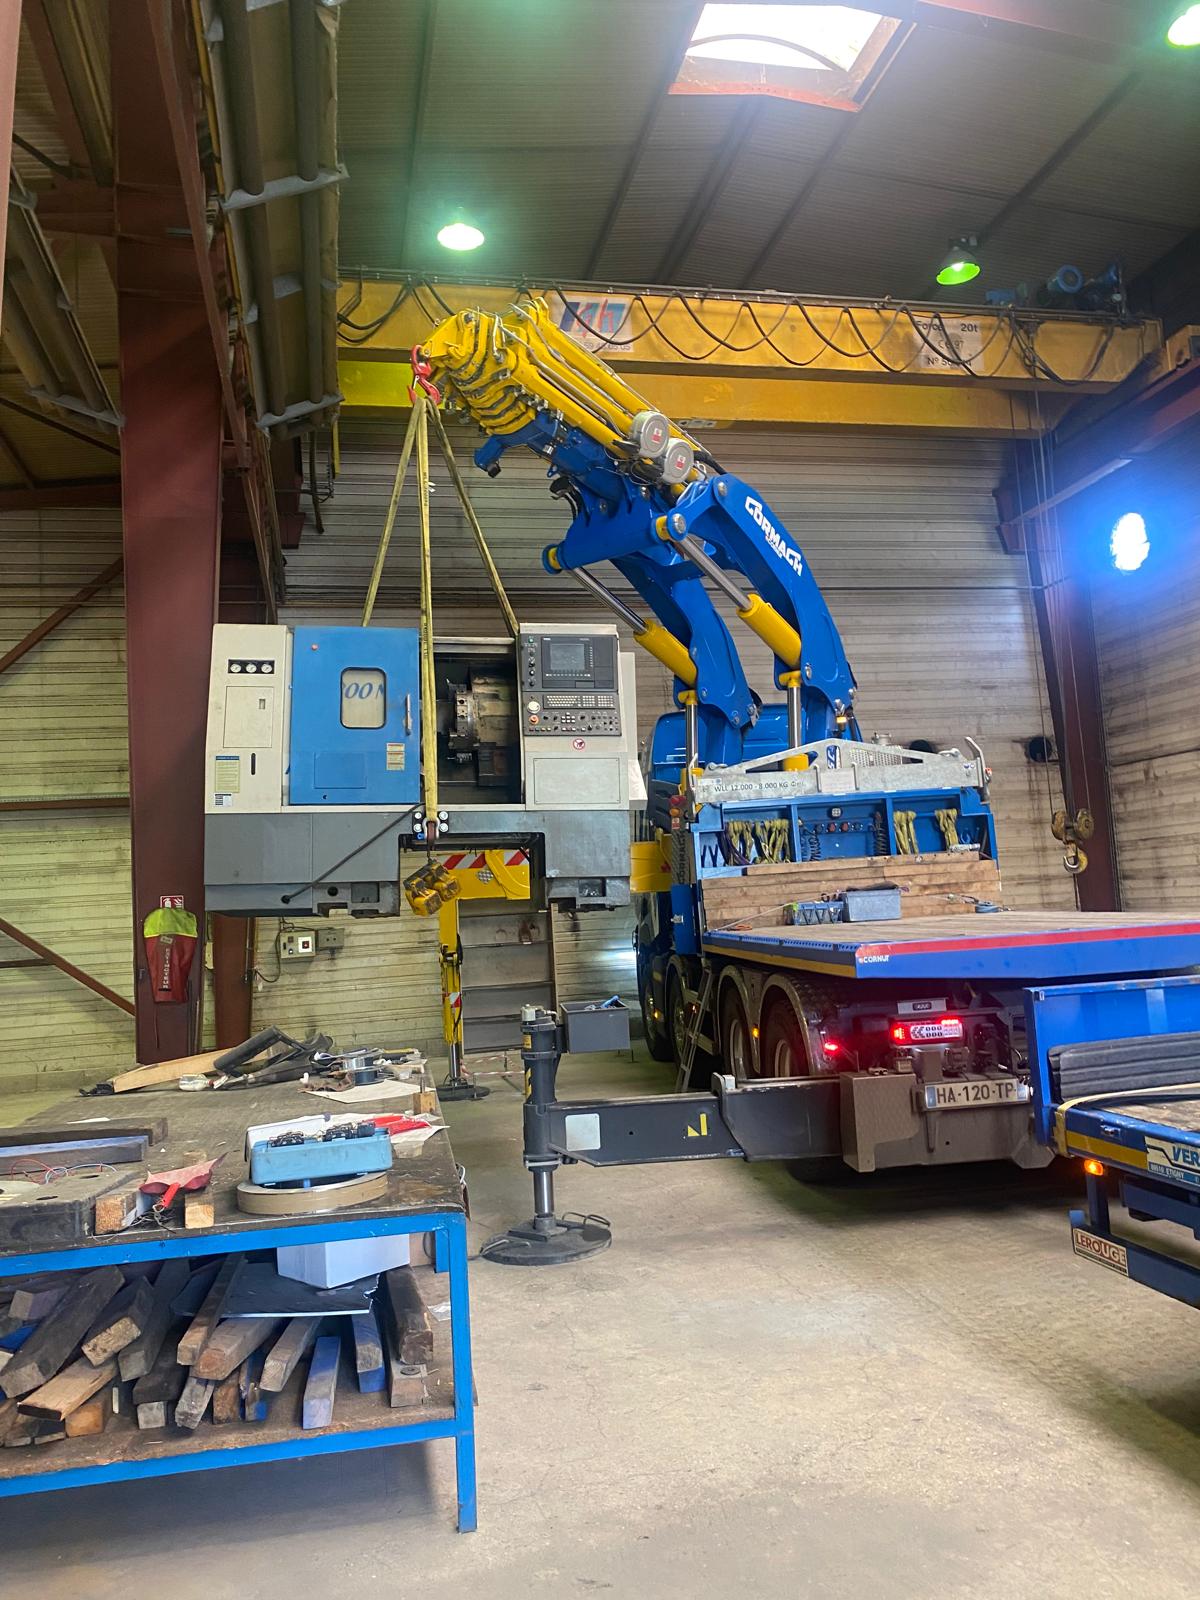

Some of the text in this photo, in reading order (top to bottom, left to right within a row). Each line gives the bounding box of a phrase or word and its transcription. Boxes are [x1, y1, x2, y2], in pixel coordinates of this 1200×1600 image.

[960, 323, 978, 333] 20t
[745, 496, 803, 577] CORMACH
[714, 785, 728, 793] WLL
[731, 783, 753, 791] 12.000
[863, 955, 890, 964] CORNUT
[1076, 1231, 1126, 1267] LEROUGE
